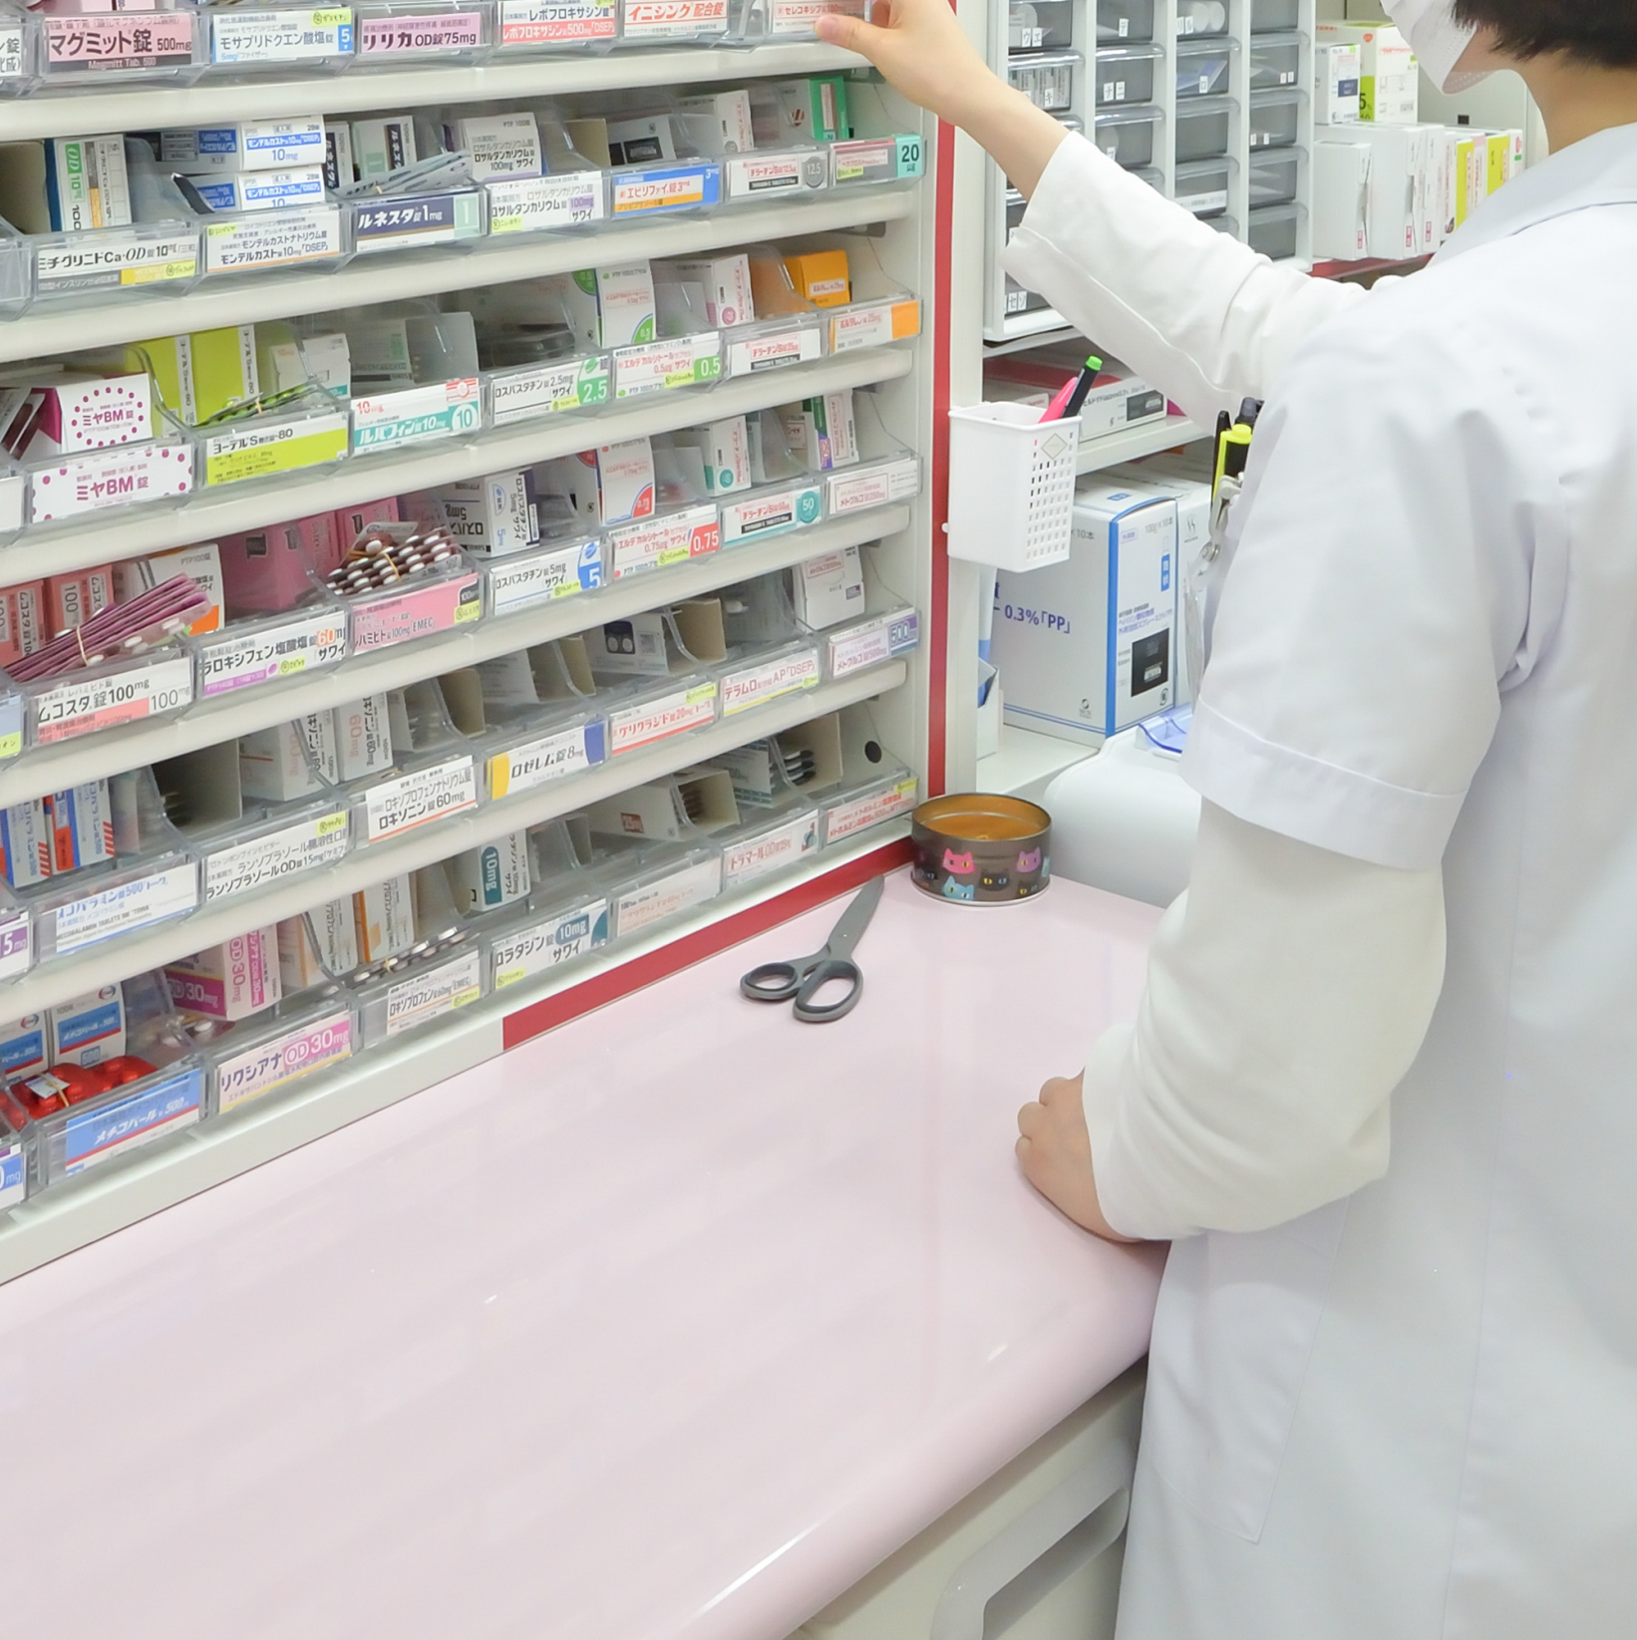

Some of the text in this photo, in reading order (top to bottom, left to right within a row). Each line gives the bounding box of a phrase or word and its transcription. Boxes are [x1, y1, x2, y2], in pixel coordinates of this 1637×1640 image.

[156, 37, 192, 53] 500mg
[271, 148, 299, 162] 10mg
[902, 144, 919, 162] 20
[701, 357, 721, 376] 0.5
[582, 381, 607, 402] 2.5
[457, 409, 473, 428] 10
[693, 531, 719, 551] 0.75
[150, 685, 191, 711] 100mg
[559, 919, 588, 940] 10mg
